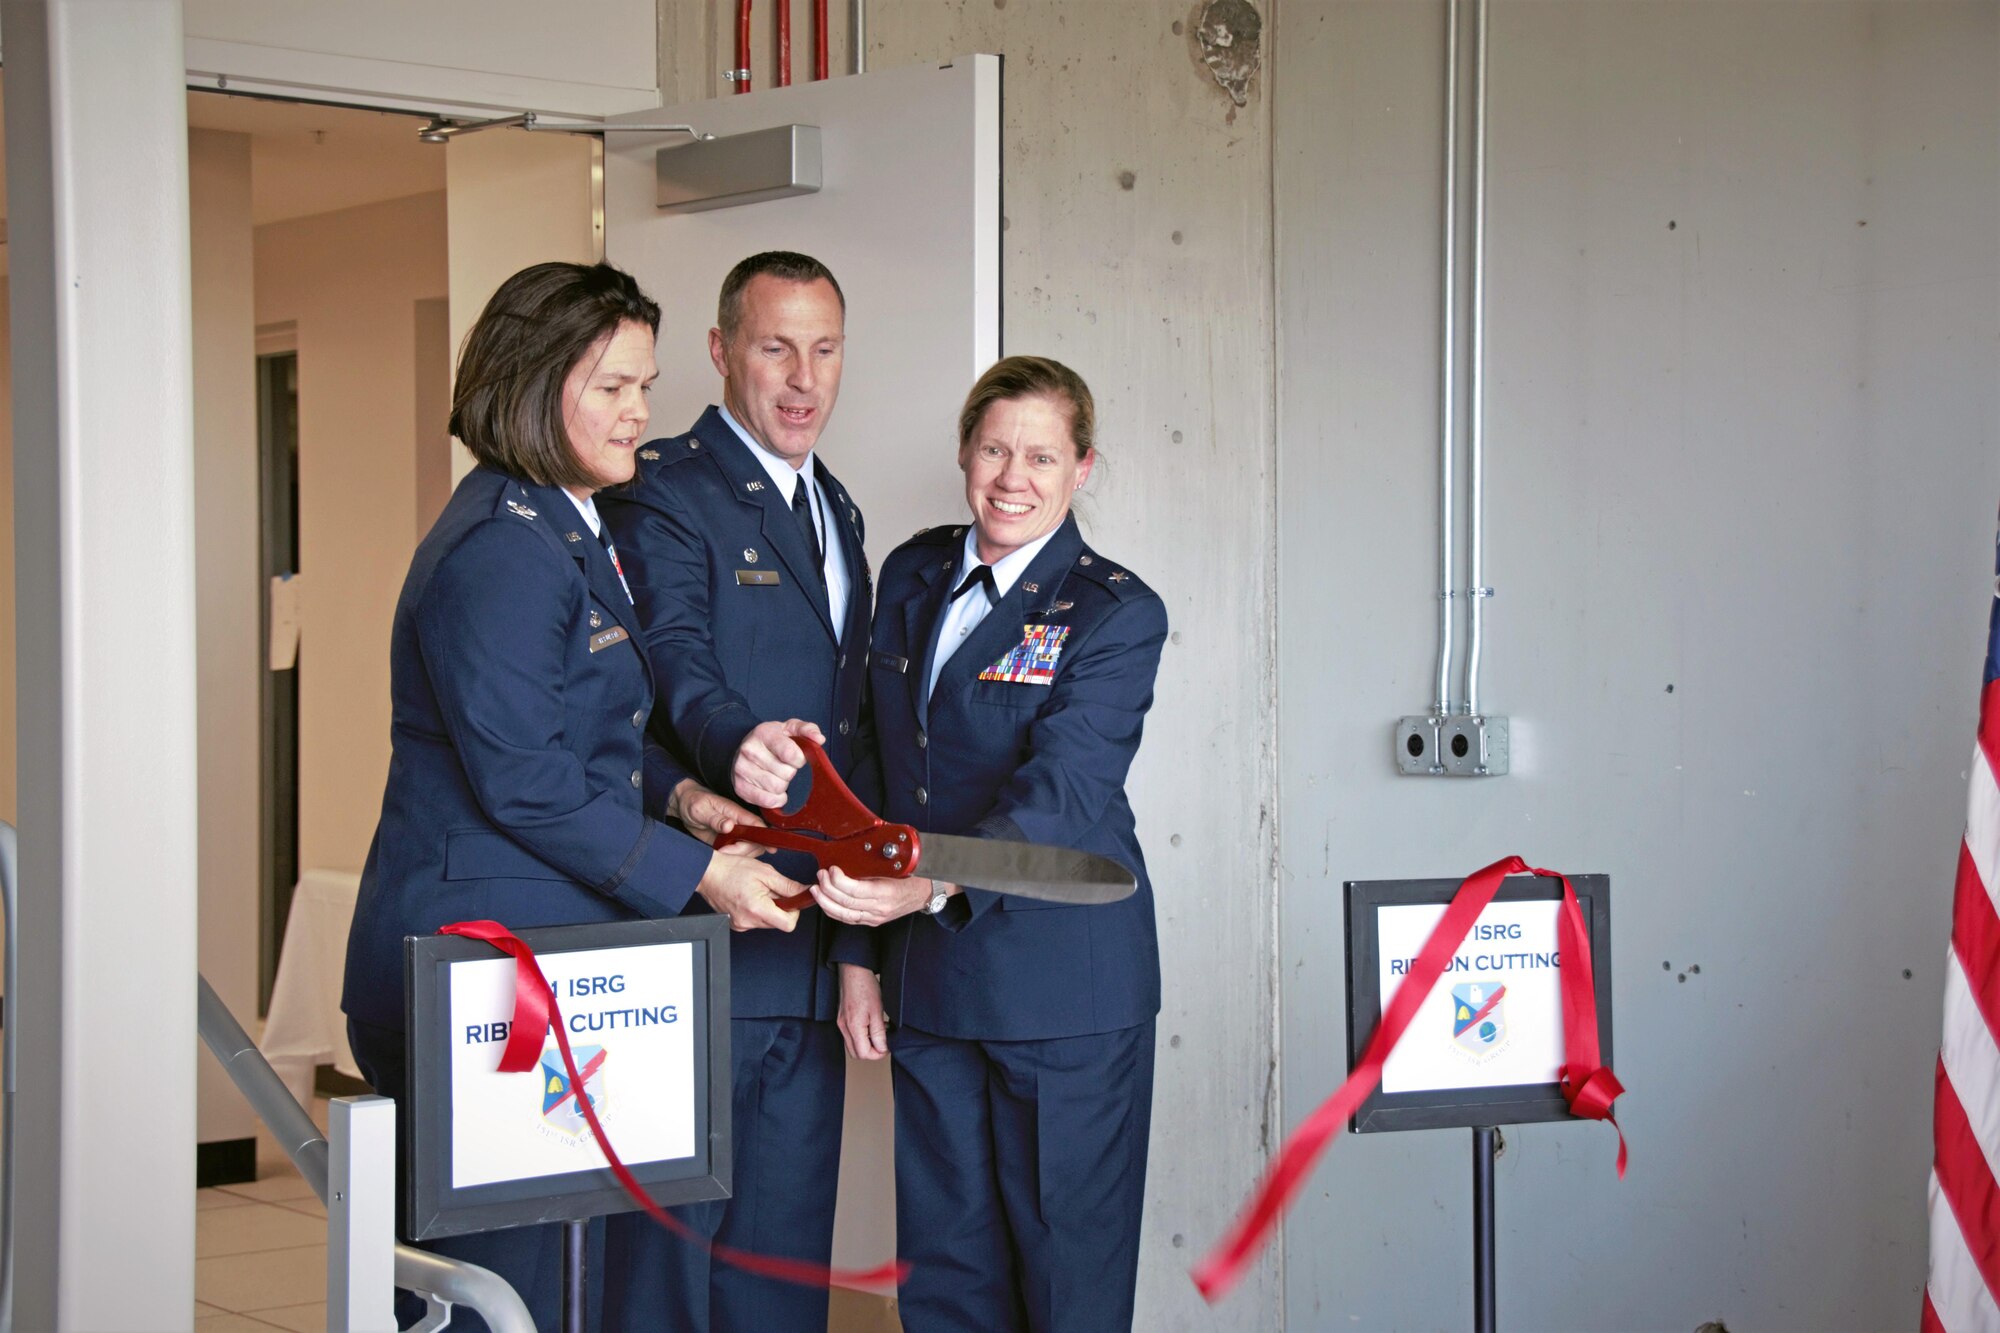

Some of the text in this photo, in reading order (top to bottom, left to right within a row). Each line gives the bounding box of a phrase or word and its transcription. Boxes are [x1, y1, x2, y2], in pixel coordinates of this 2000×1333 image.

[1474, 923, 1522, 941] ISRG
[1391, 955, 1470, 975] RION
[569, 974, 626, 997] ISRG
[569, 1005, 678, 1033] CUTTING
[579, 1113, 613, 1144] GRUP
